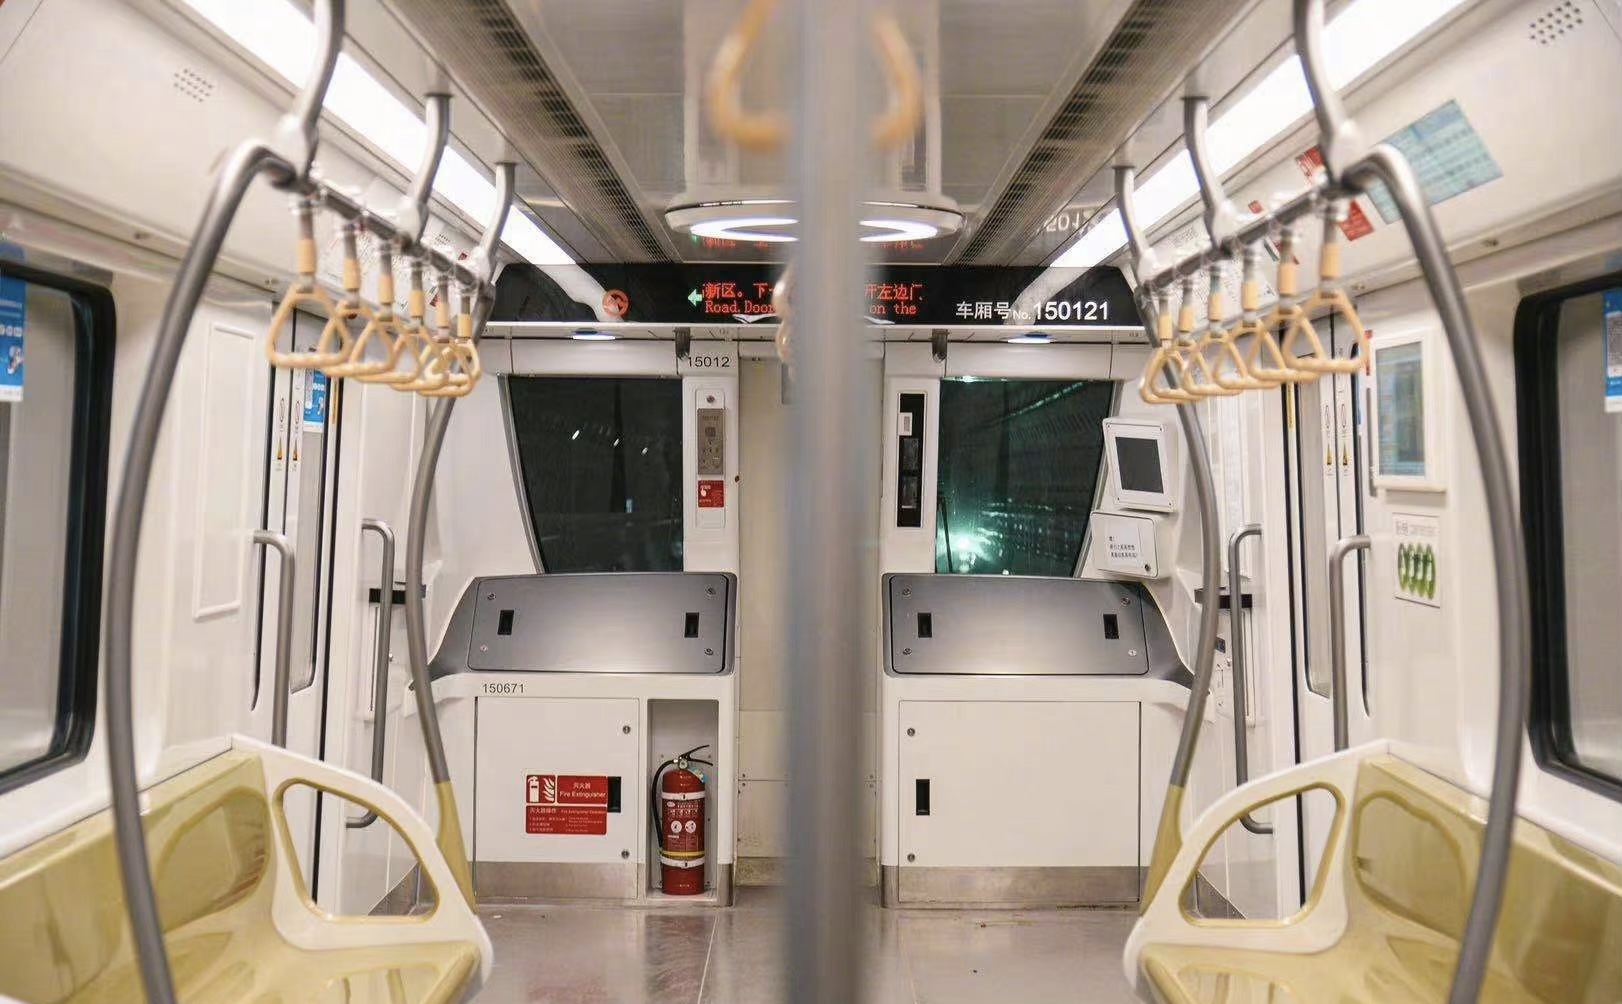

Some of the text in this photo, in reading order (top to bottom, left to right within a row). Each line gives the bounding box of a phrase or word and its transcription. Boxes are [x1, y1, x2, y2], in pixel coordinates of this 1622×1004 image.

[869, 304, 886, 314] on
[893, 301, 917, 314] the
[955, 301, 1011, 320] 车厢号
[1033, 301, 1108, 321] 150121
[688, 356, 730, 368] 15012
[482, 683, 525, 694] 150671
